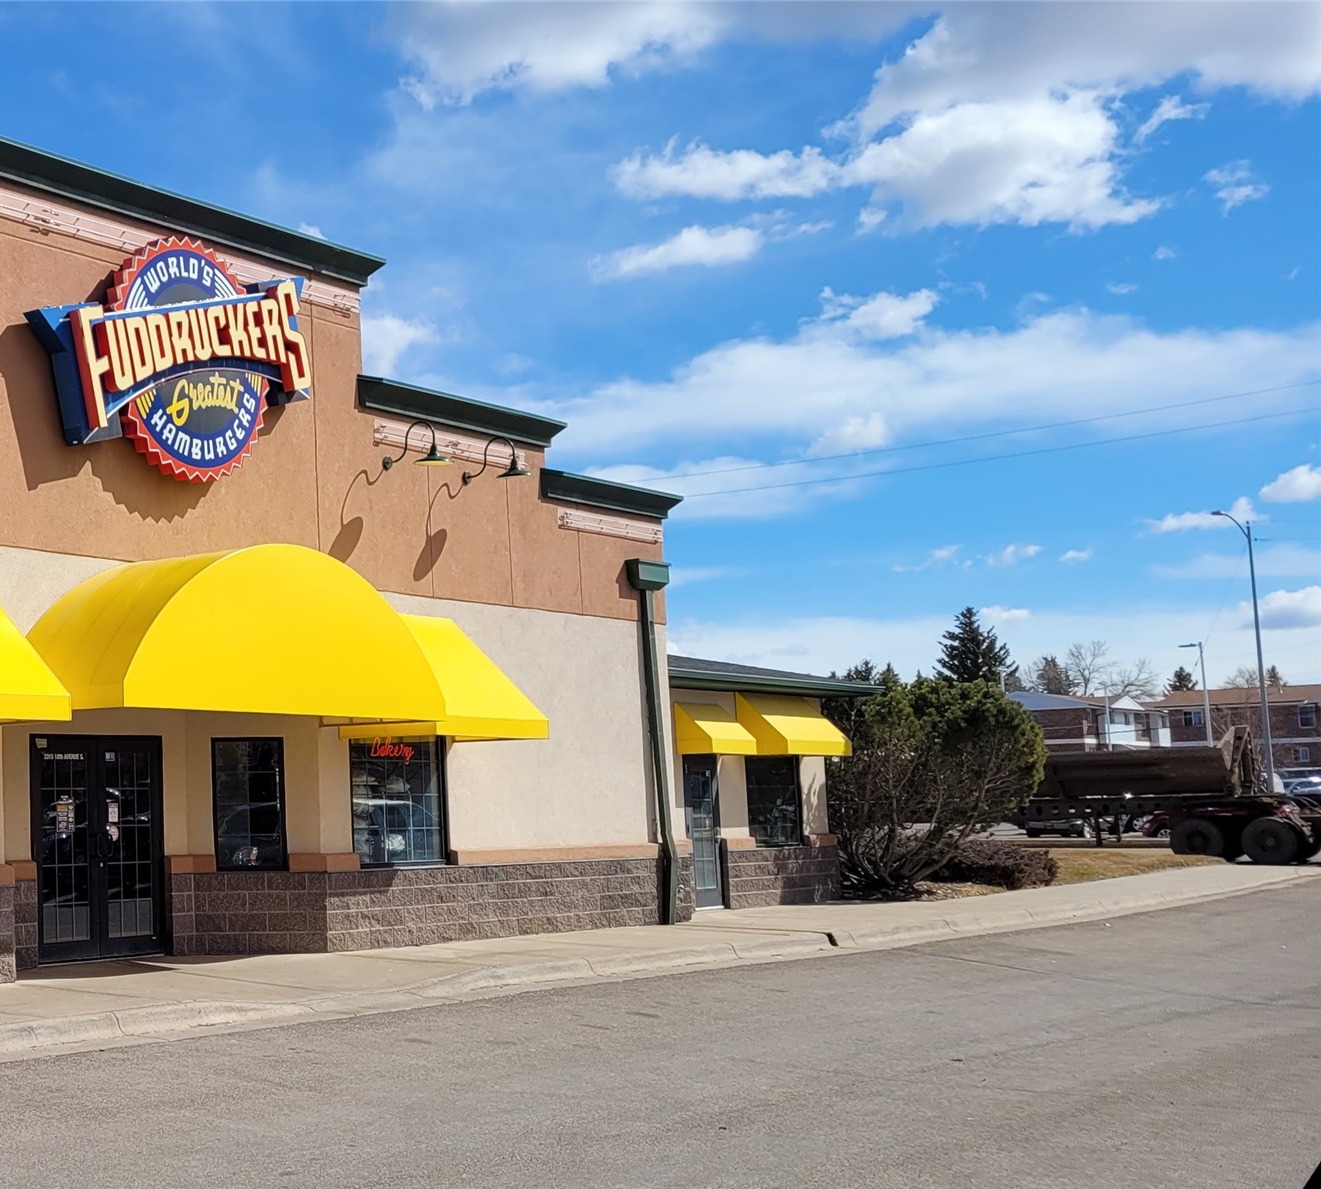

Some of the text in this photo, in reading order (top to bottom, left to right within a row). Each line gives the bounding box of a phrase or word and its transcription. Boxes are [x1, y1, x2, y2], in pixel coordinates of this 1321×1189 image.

[143, 257, 214, 291] WORLD'S
[78, 281, 311, 428] FUDDRUCKERS
[167, 372, 244, 426] Greatest
[151, 393, 256, 460] HAMBURGERS
[370, 736, 415, 765] Bakery
